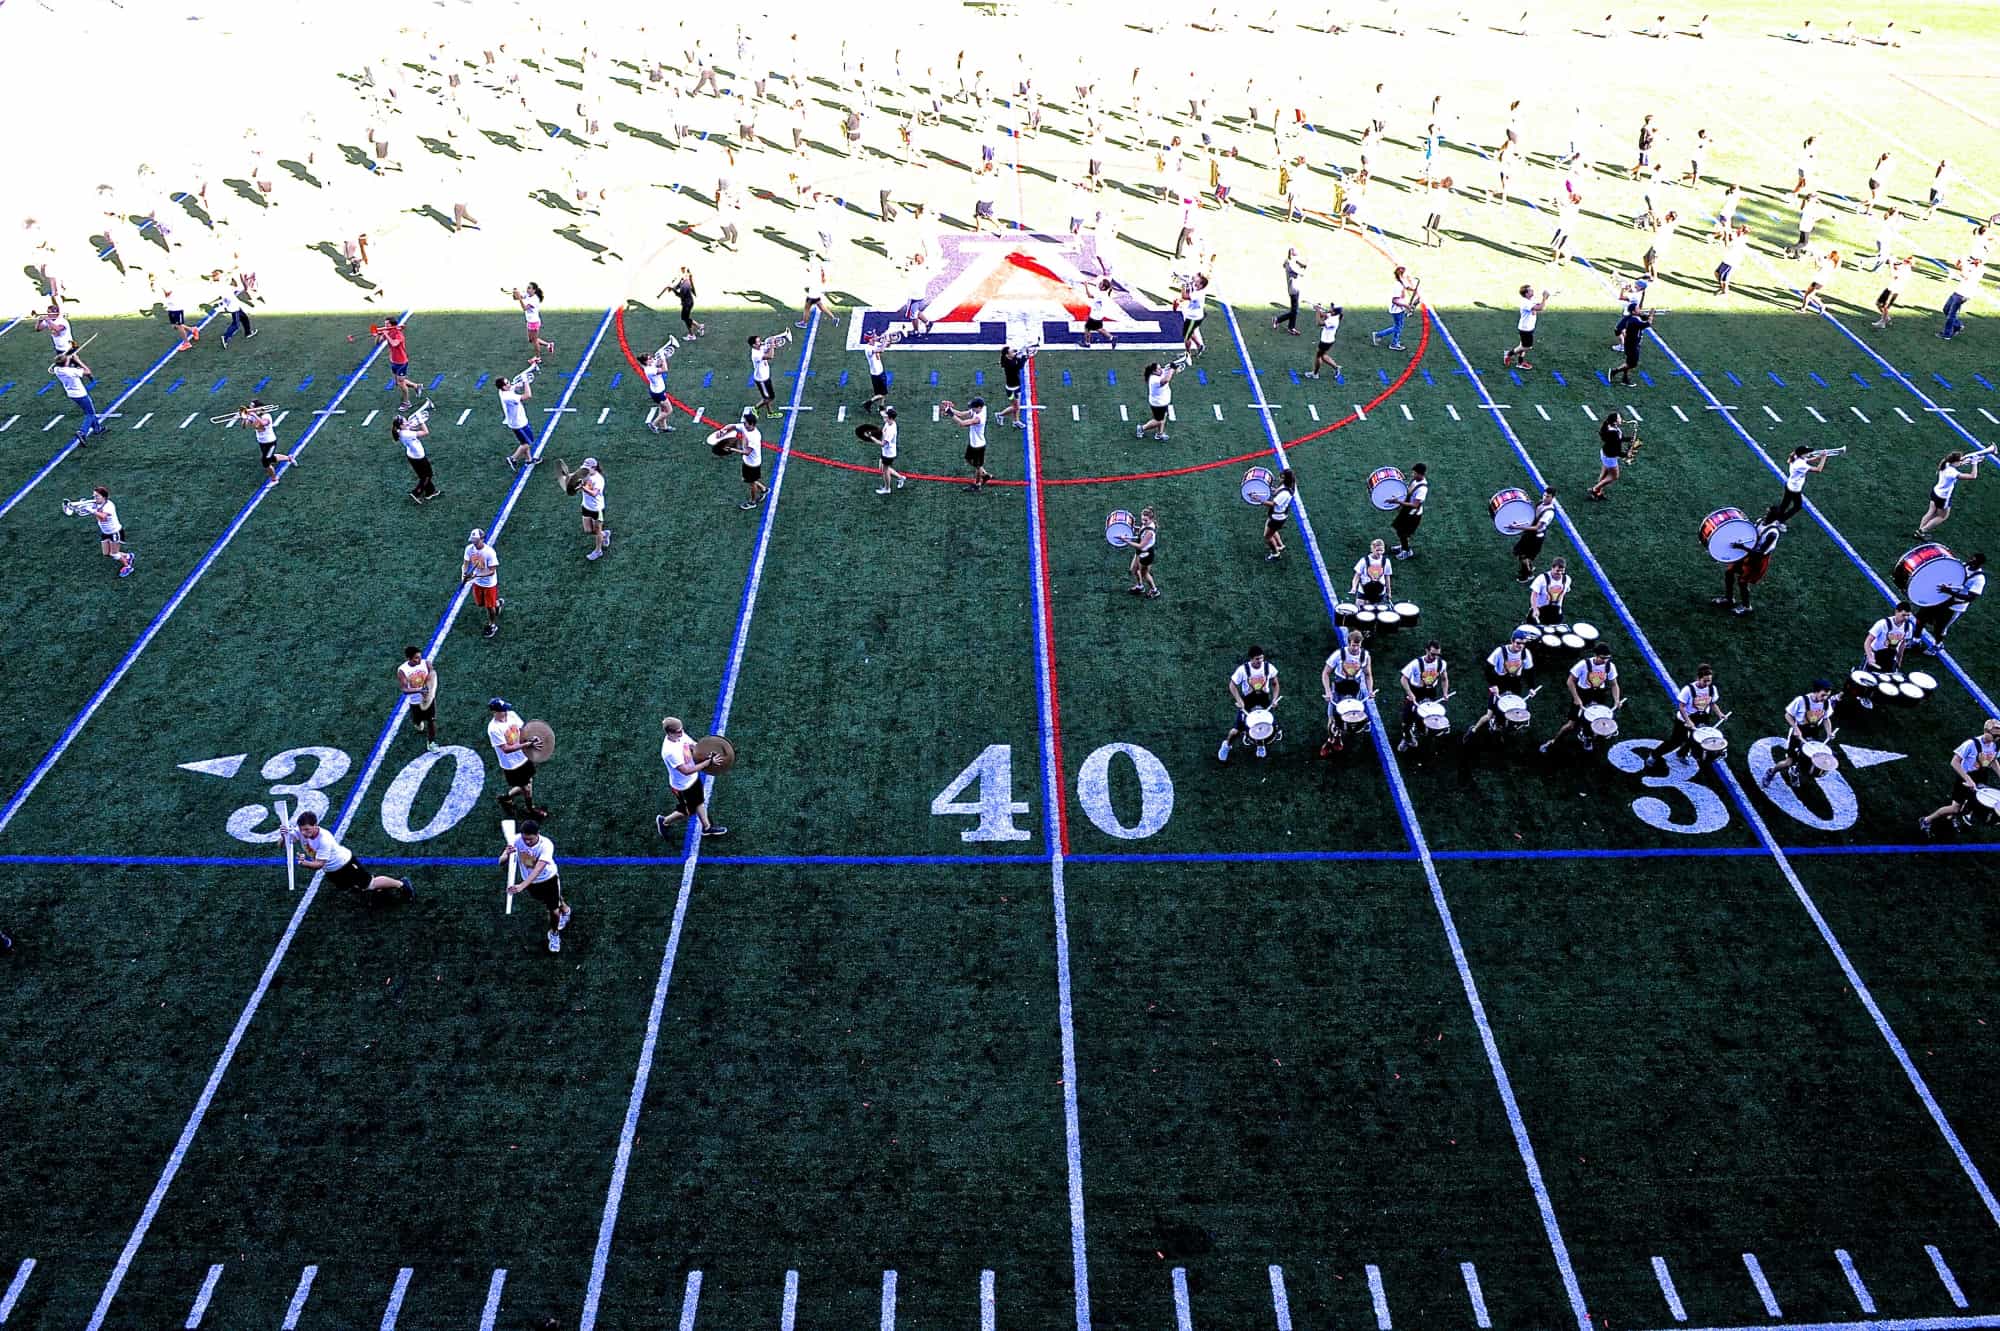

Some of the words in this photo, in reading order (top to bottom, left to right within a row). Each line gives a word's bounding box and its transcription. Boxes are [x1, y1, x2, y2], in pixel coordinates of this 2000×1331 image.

[847, 232, 1189, 350] A
[225, 745, 486, 843] 30
[931, 742, 1174, 841] 40
[1607, 736, 1858, 834] 30
